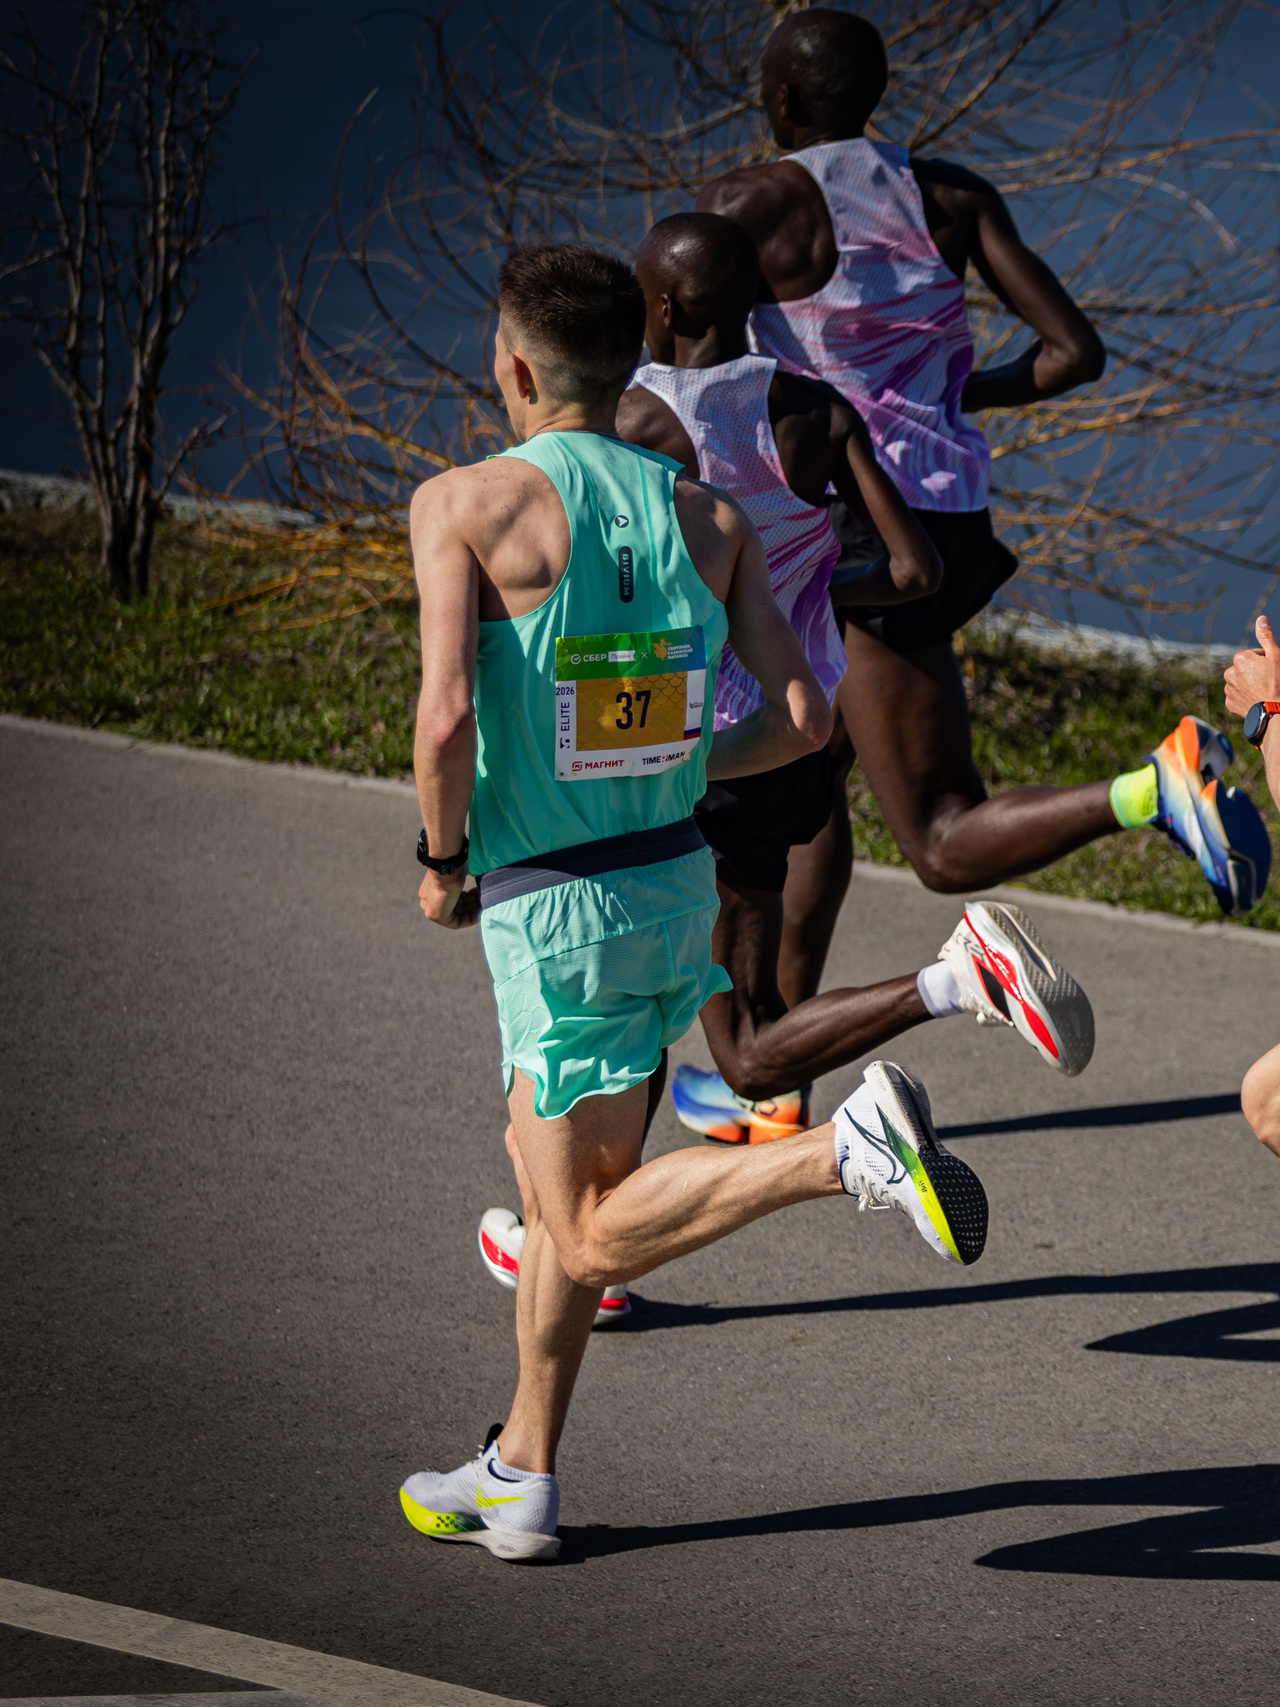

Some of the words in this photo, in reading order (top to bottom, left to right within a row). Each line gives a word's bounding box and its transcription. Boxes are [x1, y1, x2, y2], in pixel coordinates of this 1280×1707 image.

[622, 553, 630, 596] BIVIUM
[583, 653, 607, 663] СБЕР
[556, 686, 575, 696] 2026
[560, 702, 570, 732] ELITE
[615, 689, 651, 730] 37
[585, 759, 625, 770] МАГНИТ
